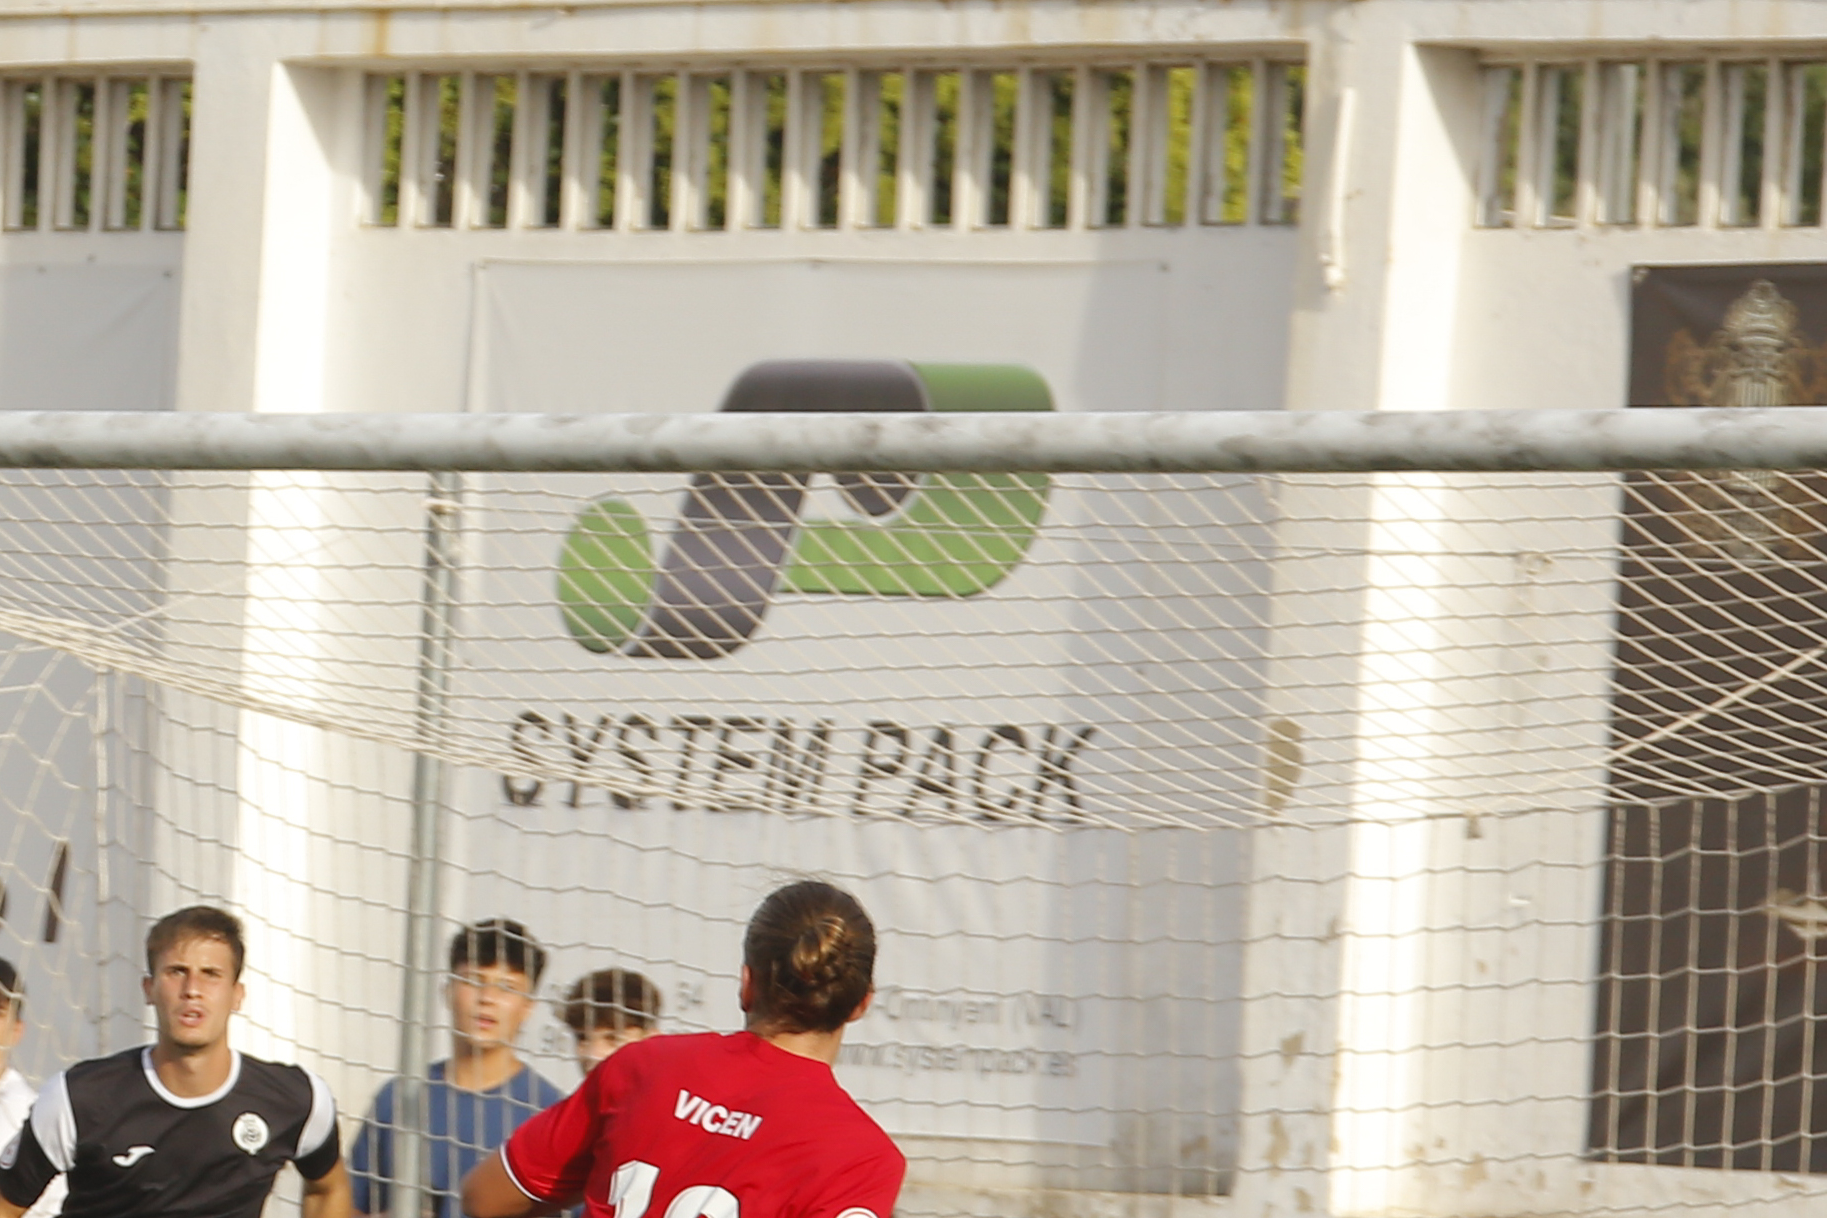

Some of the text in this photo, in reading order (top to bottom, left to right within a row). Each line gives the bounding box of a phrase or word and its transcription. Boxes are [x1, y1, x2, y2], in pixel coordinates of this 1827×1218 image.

[501, 710, 1101, 823] SYSTEM PACK
[673, 1089, 762, 1141] VICEN
